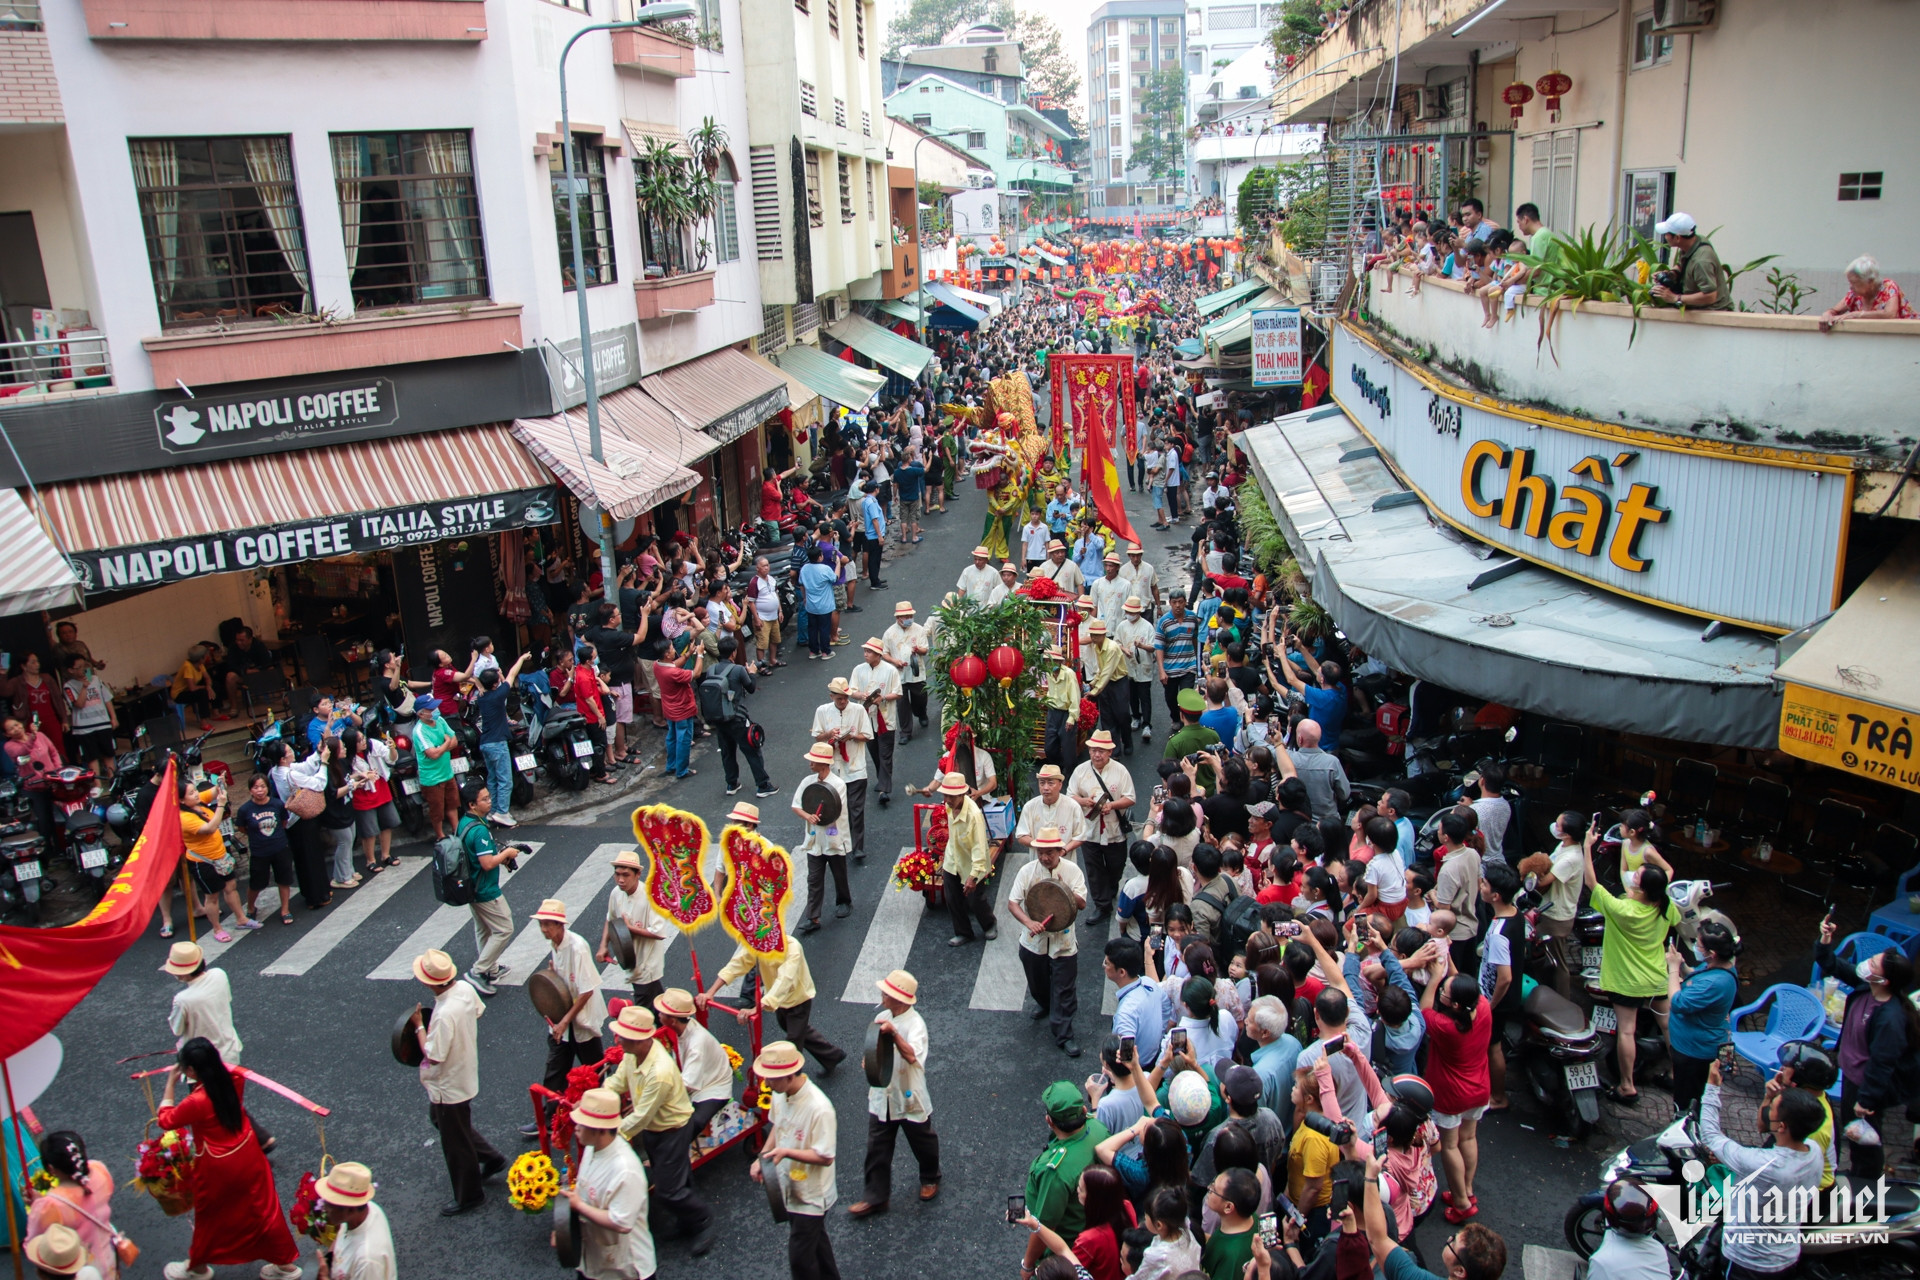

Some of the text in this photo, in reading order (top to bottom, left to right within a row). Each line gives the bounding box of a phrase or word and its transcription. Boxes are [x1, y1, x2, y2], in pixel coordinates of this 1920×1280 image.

[1254, 318, 1269, 330] NHANG
[602, 344, 626, 370] COFFEE
[1276, 352, 1298, 368] MINH
[207, 386, 380, 433] NAPOLI COFFEE
[294, 416, 368, 432] ITALIA STYLE
[441, 500, 506, 526] STYLE
[1460, 439, 1670, 574] Chất
[380, 521, 492, 546] DĐ: 0973.831.713
[572, 521, 582, 558] NAPOLI
[98, 540, 226, 588] NAPOLI
[234, 522, 352, 566] COFFEE
[424, 584, 444, 628] NAPOLI
[1784, 725, 1834, 748] 0931.811.872
[1816, 720, 1836, 735] LỘC
[1846, 713, 1912, 760] TRÀ
[1864, 760, 1920, 787] 177A LƯ
[1568, 1075, 1597, 1088] 118.71
[1569, 1065, 1593, 1077] 59-L3
